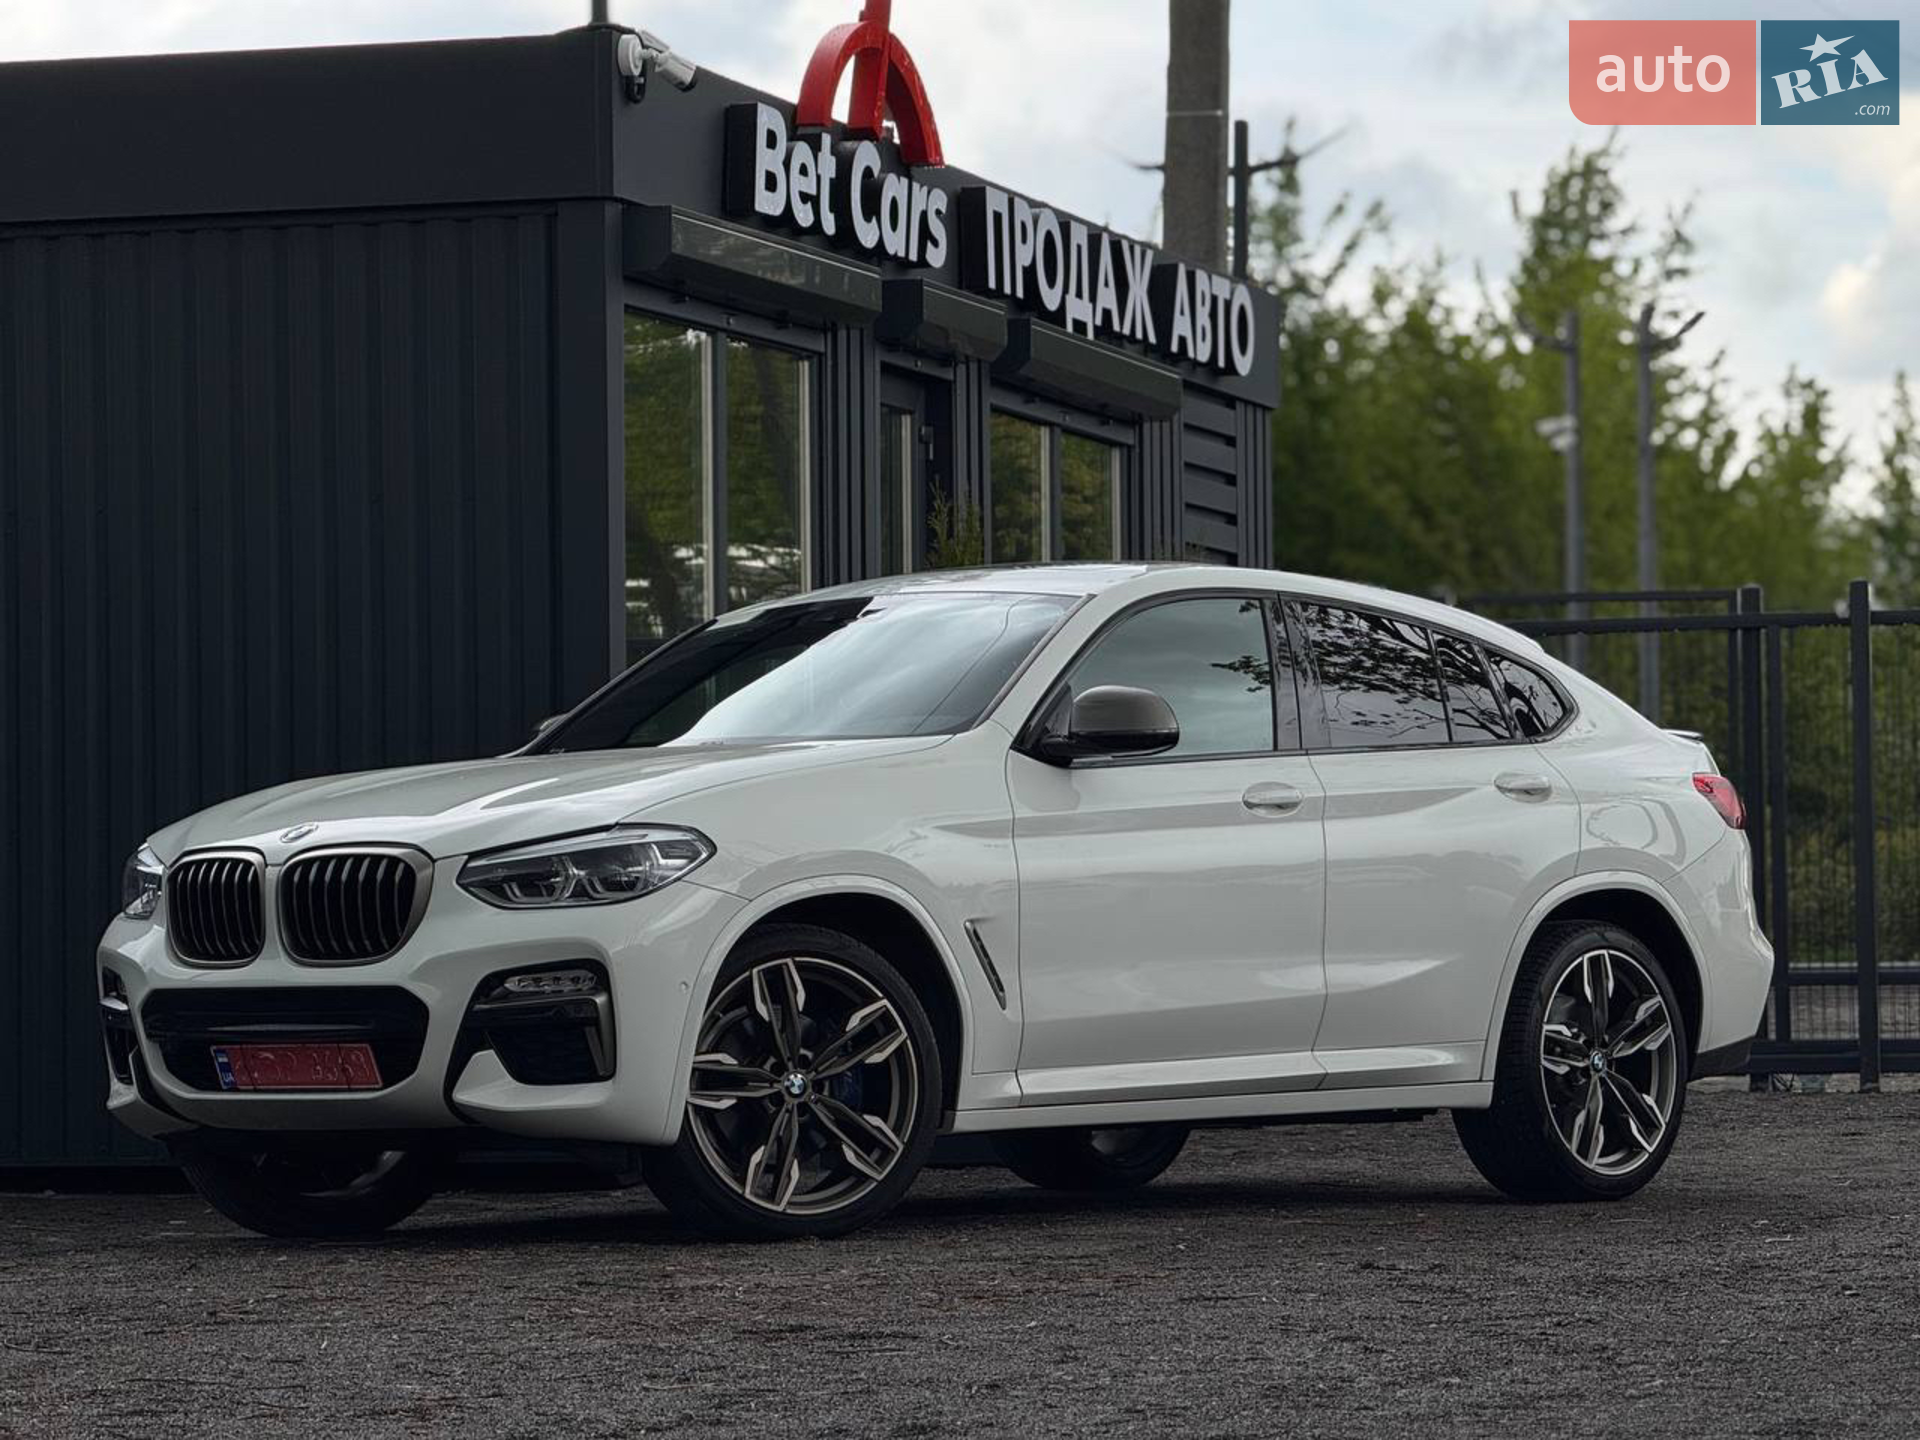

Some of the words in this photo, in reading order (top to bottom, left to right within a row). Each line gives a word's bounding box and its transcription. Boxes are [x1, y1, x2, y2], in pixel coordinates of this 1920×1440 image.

[754, 102, 837, 237] Bet
[850, 140, 948, 269] Cars
[984, 185, 1157, 345] ПРОДАЖ
[1170, 262, 1255, 377] АВТО
